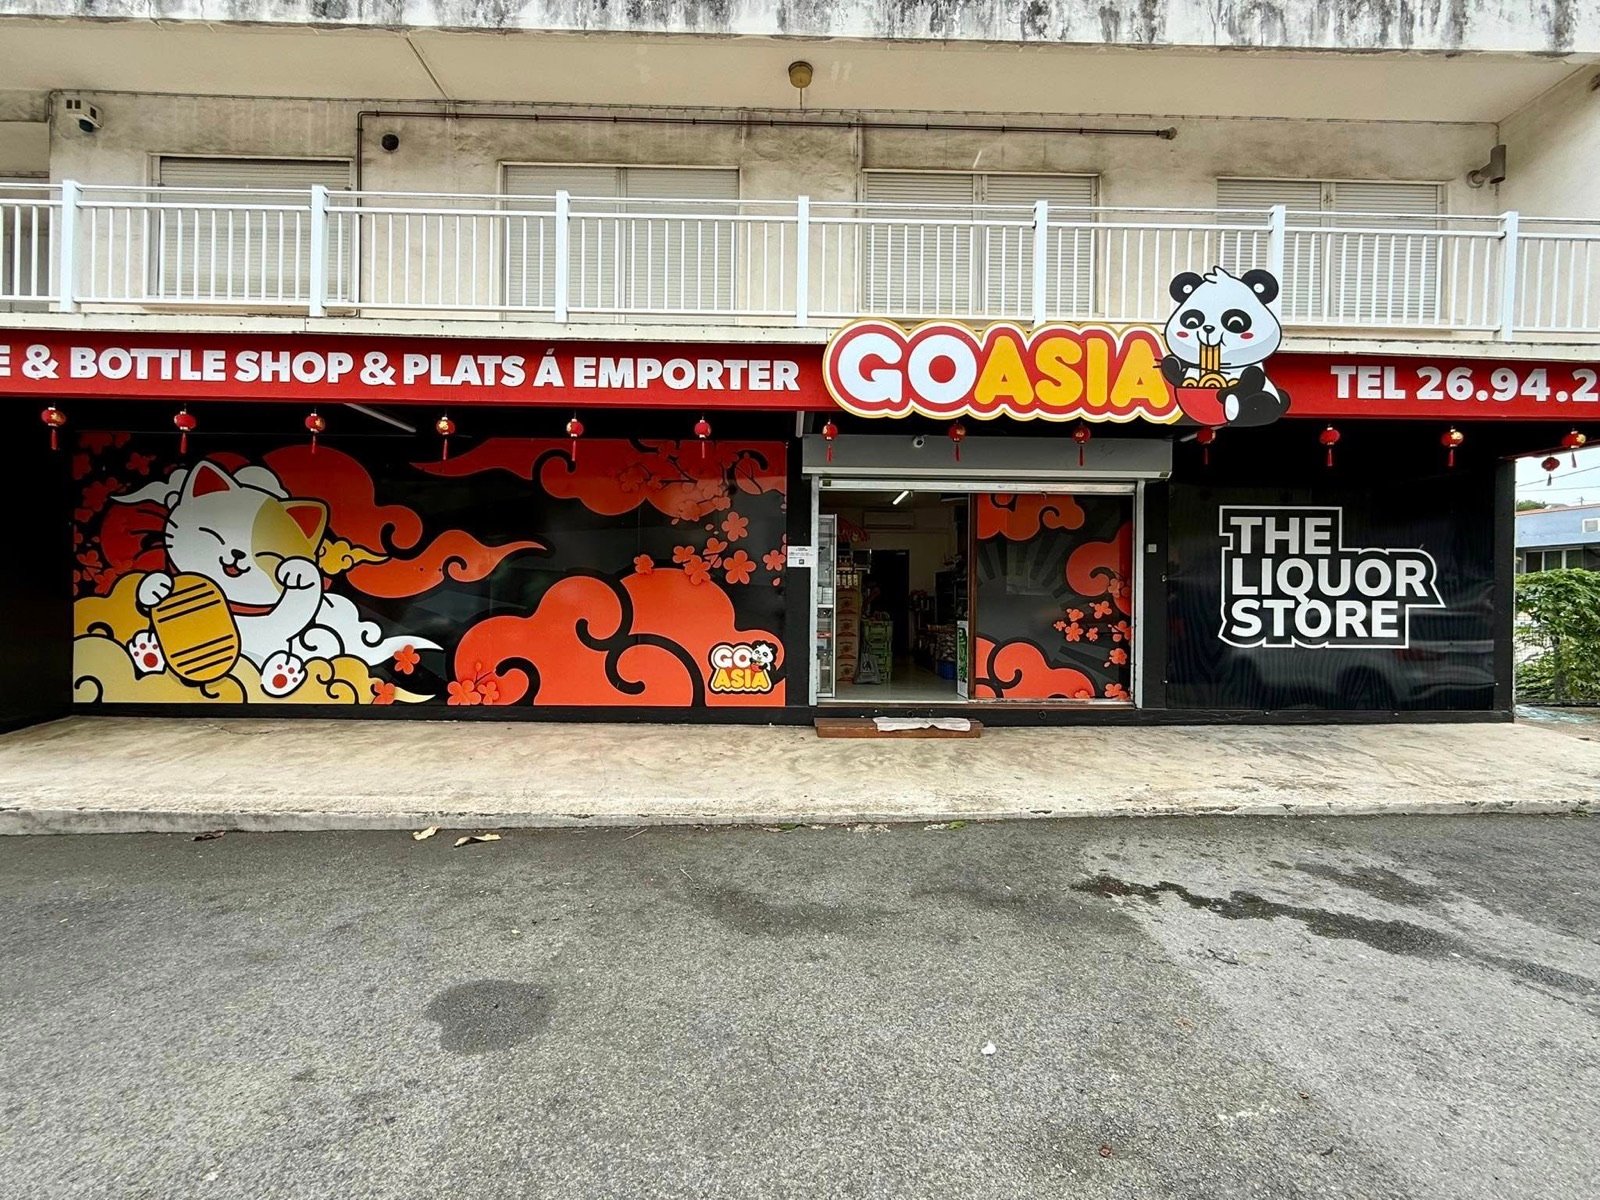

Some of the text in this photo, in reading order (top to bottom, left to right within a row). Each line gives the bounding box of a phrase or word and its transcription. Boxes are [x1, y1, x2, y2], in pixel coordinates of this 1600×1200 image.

[22, 344, 60, 380] &
[70, 346, 227, 381] BOTTLE
[235, 350, 354, 383] SHOP
[359, 351, 397, 386] &
[403, 353, 526, 388] PLATS
[533, 347, 565, 388] Á
[573, 356, 800, 391] EMPORTER
[1330, 365, 1599, 402] TEL 26.94.2
[1230, 516, 1332, 555] THE
[1231, 557, 1429, 603] LIQUOR
[1230, 598, 1399, 638] STORE
[713, 647, 753, 669] GO
[713, 668, 769, 689] ASIA
